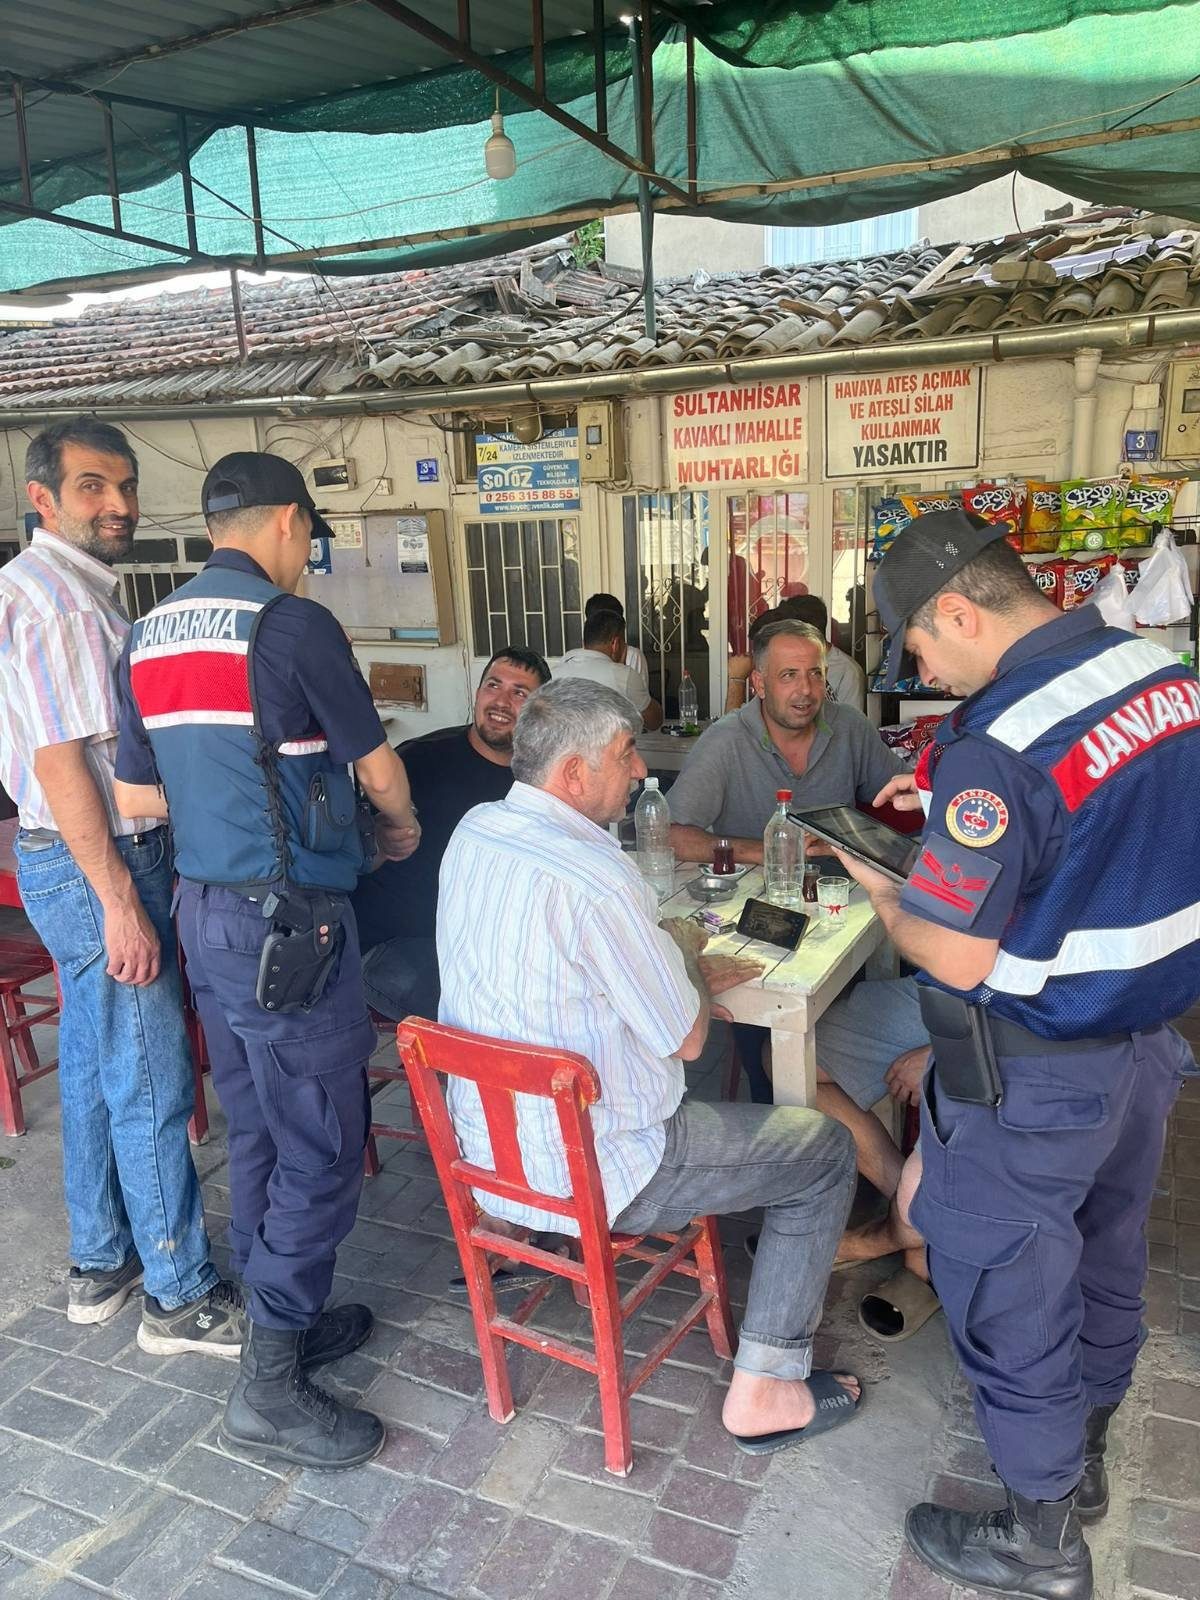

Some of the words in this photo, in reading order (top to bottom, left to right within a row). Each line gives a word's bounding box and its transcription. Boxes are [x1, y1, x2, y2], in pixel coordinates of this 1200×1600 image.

[835, 378, 882, 399] HAVAYA
[886, 374, 918, 393] ATEŞ
[922, 368, 971, 391] AÇMAK
[673, 382, 800, 417] SULTANHİSAR
[850, 403, 864, 419] VE
[868, 394, 909, 418] ATEŞLİ
[914, 393, 953, 414] SİLAH
[673, 423, 731, 450] KAVAKLI
[735, 417, 802, 445] MAHALLE
[861, 418, 941, 441] KULLANMAK
[1136, 435, 1145, 449] 3
[478, 446, 498, 463] 7/24
[678, 449, 800, 483] MUHTARLIĞI
[853, 439, 947, 468] YASAKTIR
[495, 492, 516, 502] 256
[519, 491, 540, 501] 315
[542, 490, 556, 499] 88
[559, 489, 573, 499] 55
[137, 608, 238, 650] JANDARMA
